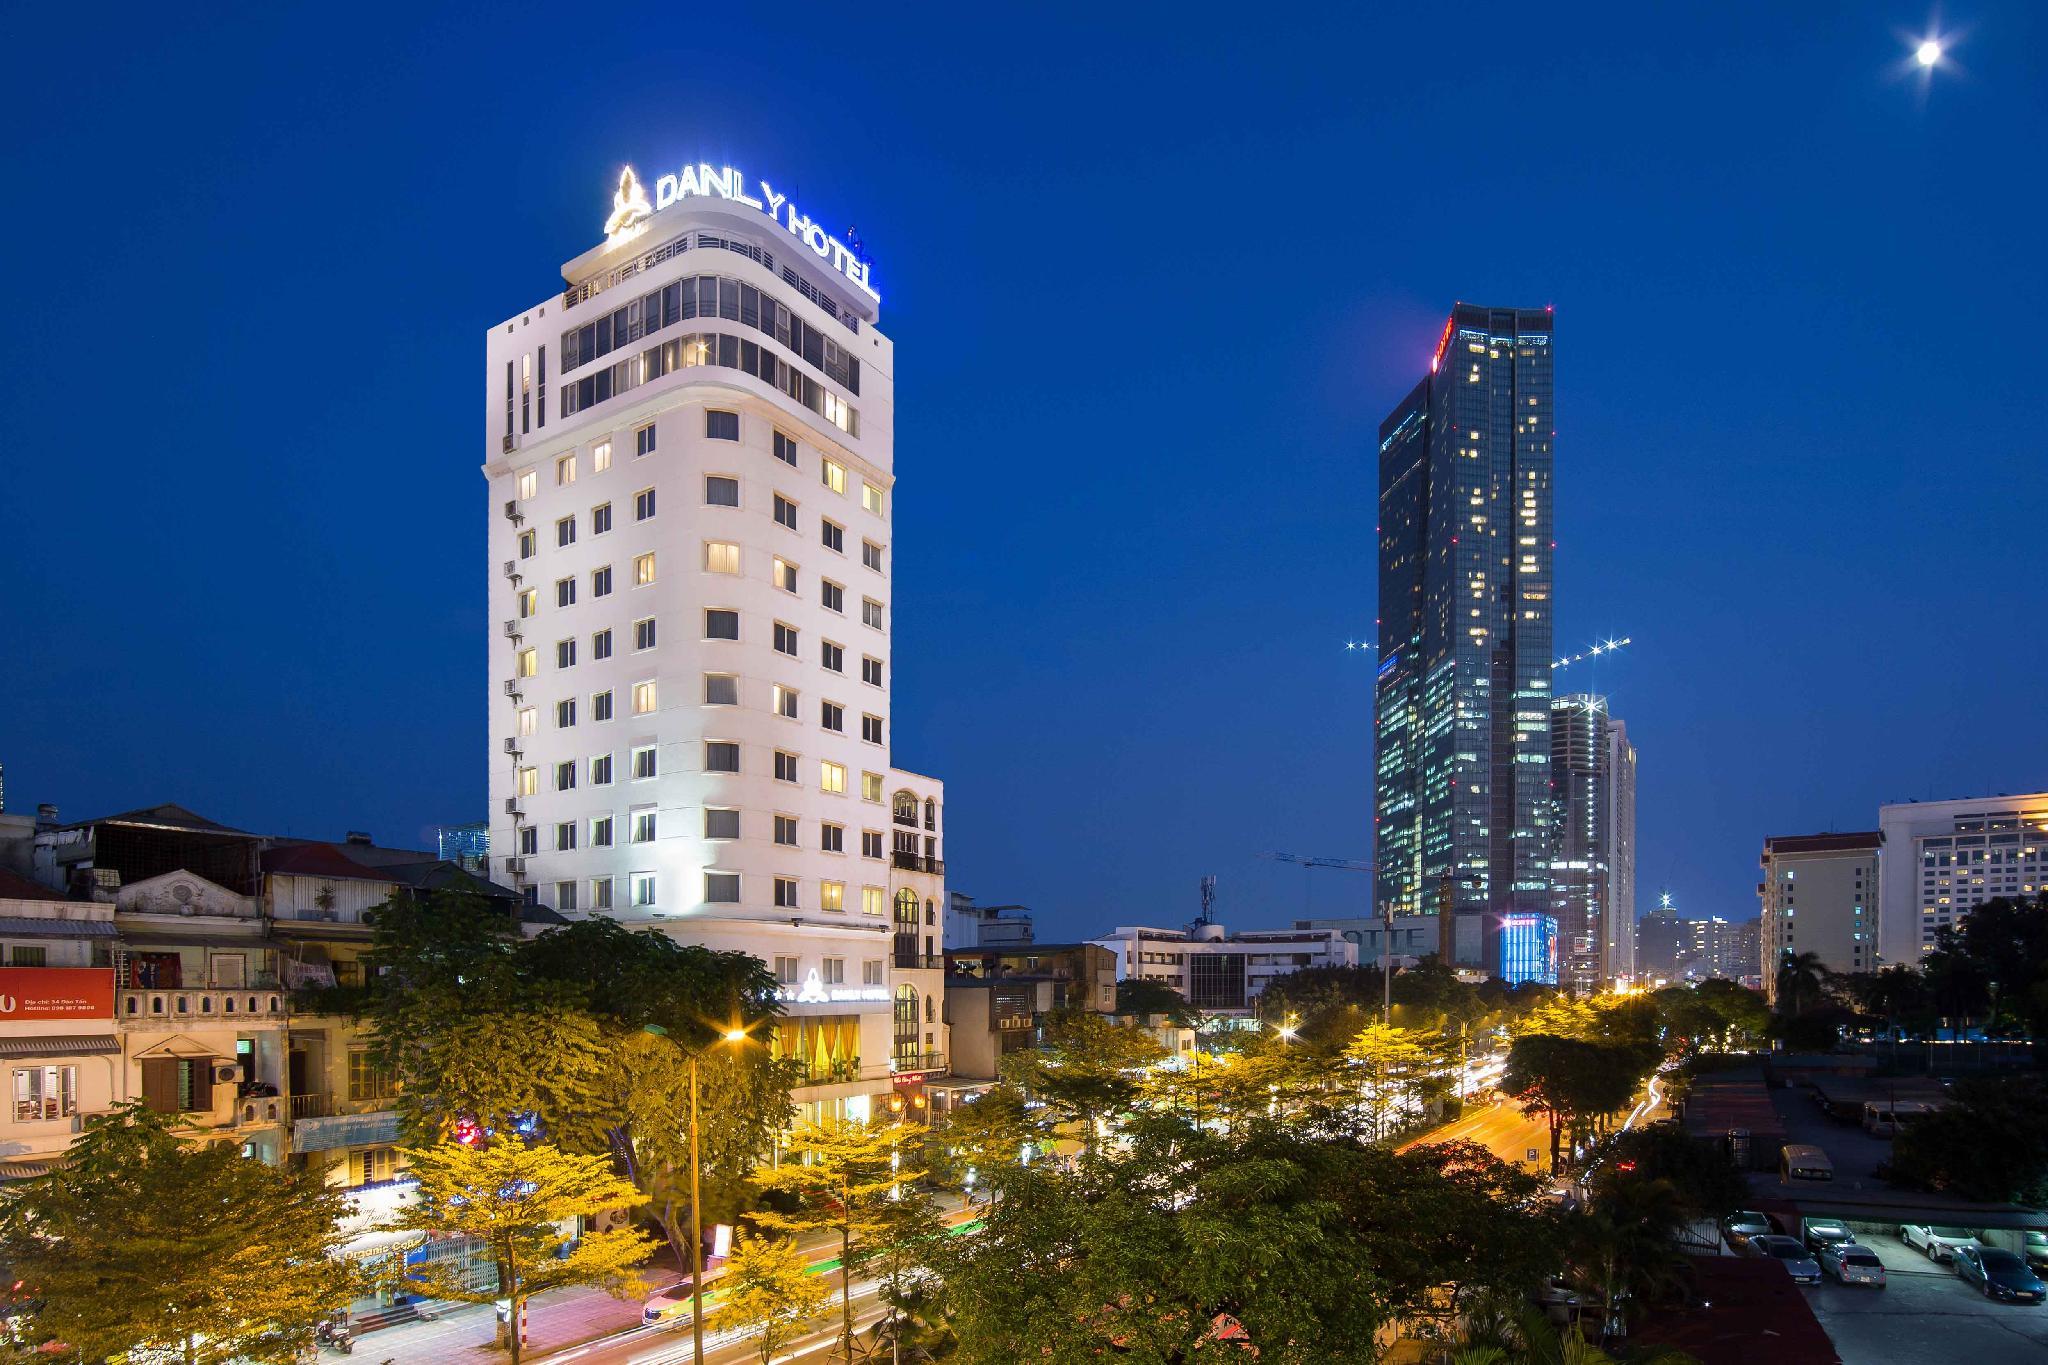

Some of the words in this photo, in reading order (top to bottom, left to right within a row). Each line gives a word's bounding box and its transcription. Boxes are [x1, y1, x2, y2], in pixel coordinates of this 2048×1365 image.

[656, 163, 786, 221] DANLY
[788, 203, 881, 304] HOTEL
[344, 1246, 389, 1260] Organic
